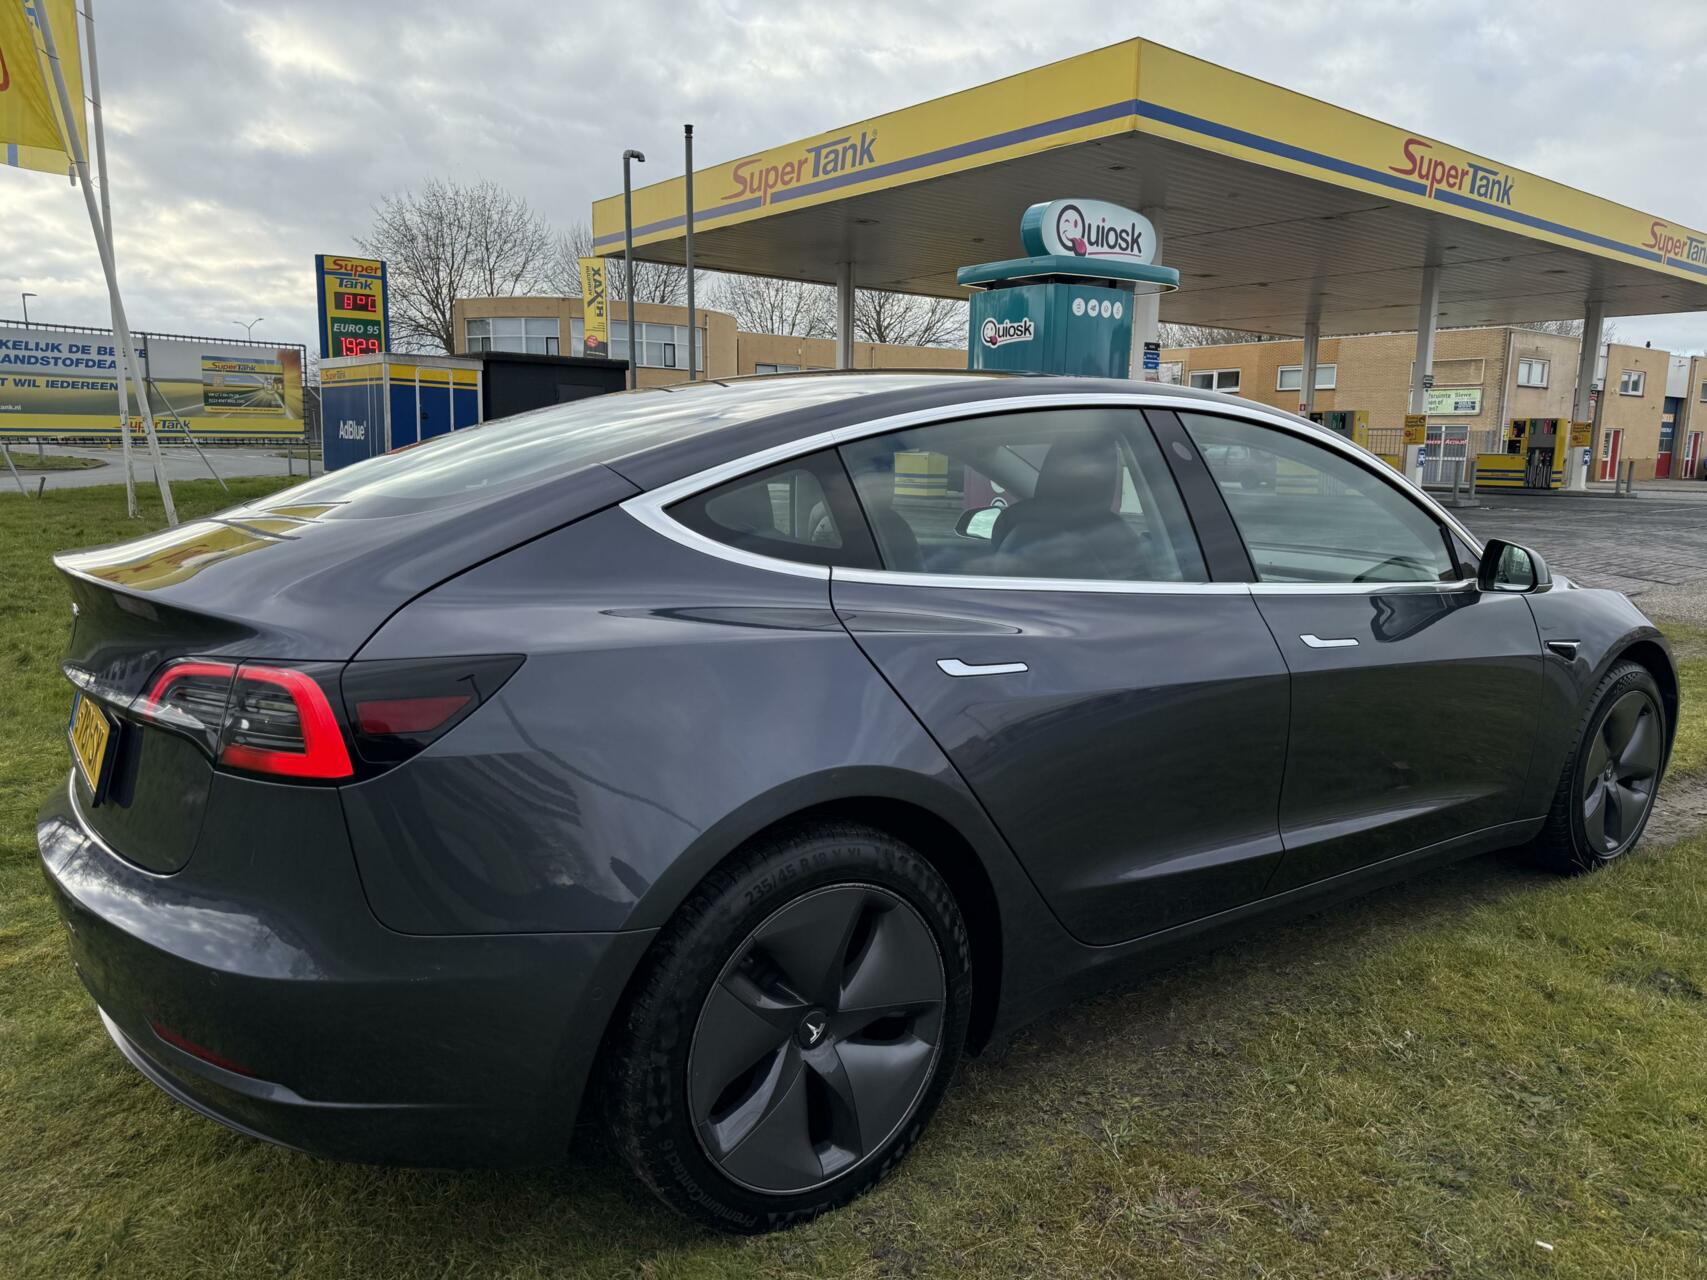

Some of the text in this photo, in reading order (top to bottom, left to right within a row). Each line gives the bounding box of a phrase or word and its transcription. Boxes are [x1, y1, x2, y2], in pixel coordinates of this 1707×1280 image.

[1056, 204, 1142, 256] Quiosk
[1641, 221, 1707, 264] SuperTan
[323, 259, 380, 278] Super
[334, 276, 373, 291] Tank
[333, 323, 379, 335] EURO 95
[983, 320, 1032, 346] Quiosk
[68, 344, 91, 355] DE
[96, 346, 148, 359] BEE
[0, 353, 117, 370] ANDSTOFDEA
[13, 378, 41, 388] WIL
[45, 380, 118, 391] IEDEREEN
[113, 417, 191, 435] uprTank
[745, 864, 797, 905] 235/45
[799, 858, 810, 873] R
